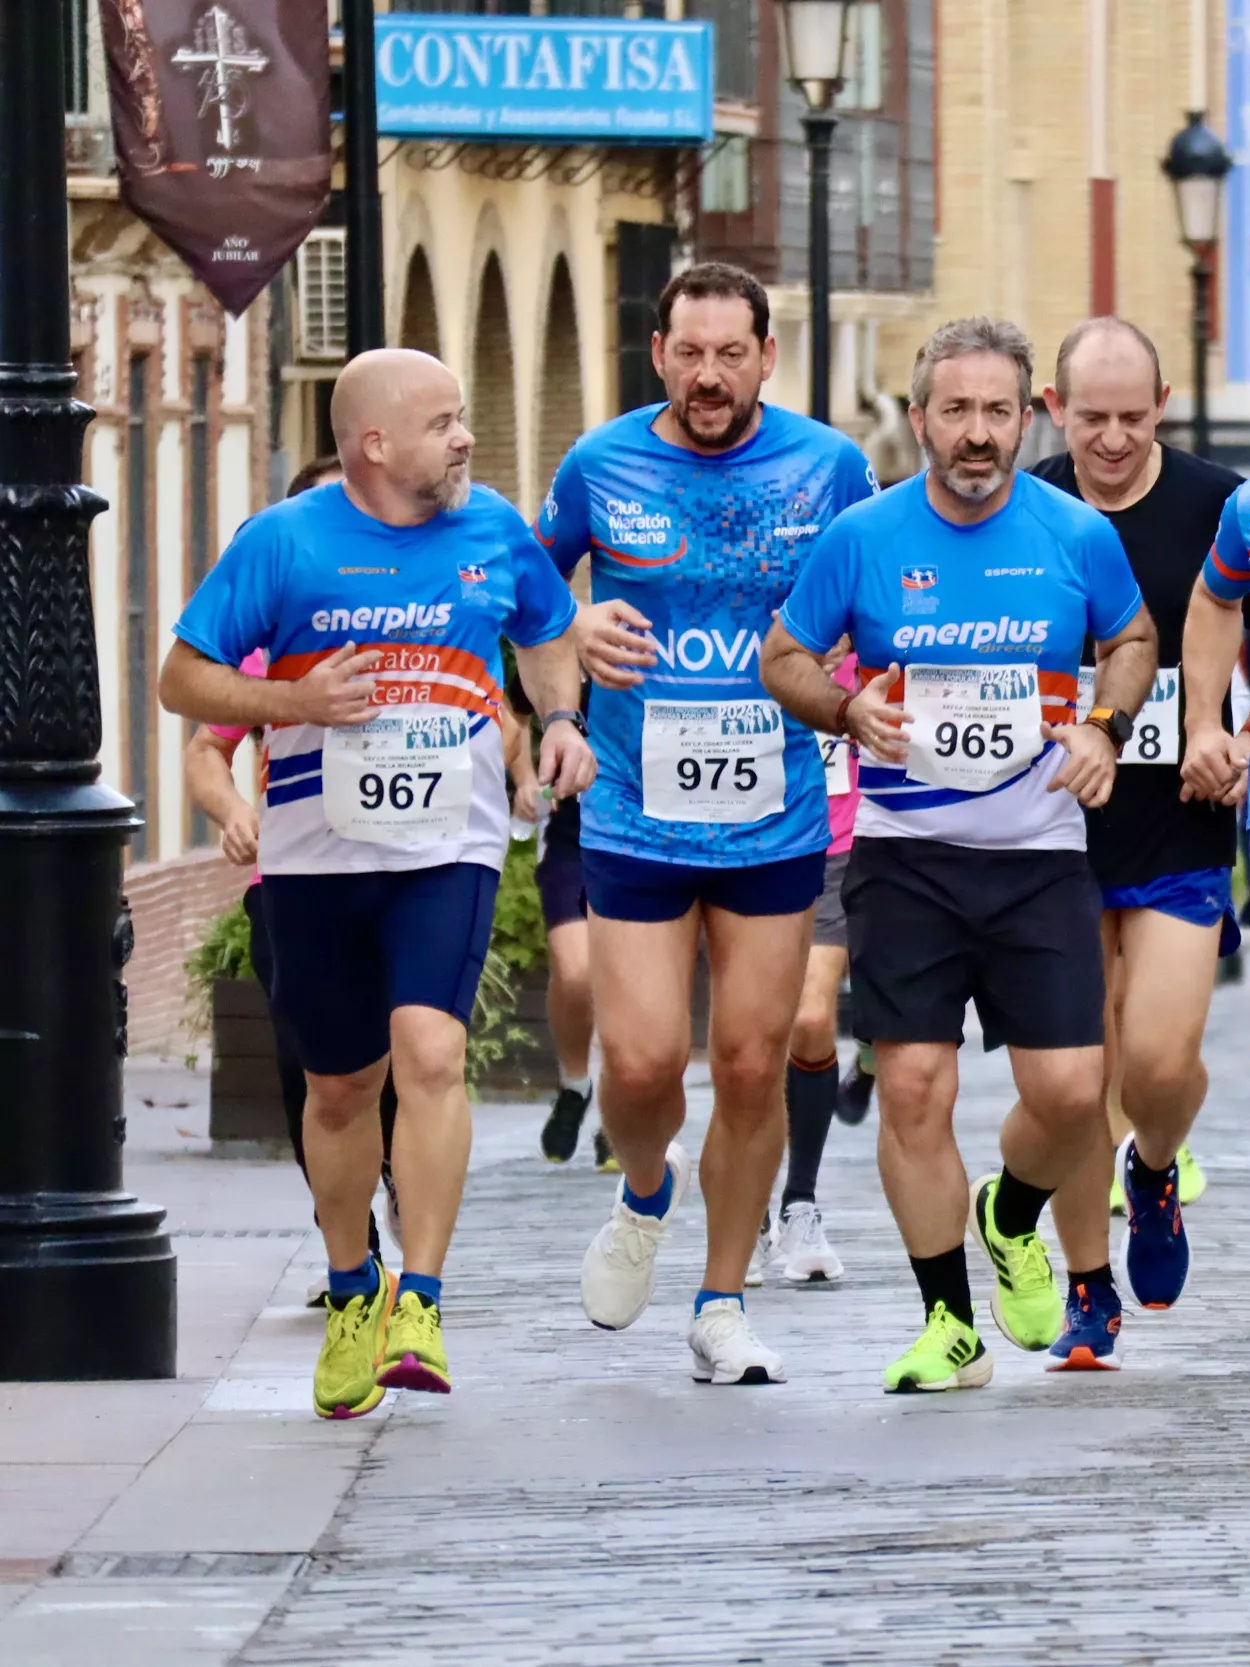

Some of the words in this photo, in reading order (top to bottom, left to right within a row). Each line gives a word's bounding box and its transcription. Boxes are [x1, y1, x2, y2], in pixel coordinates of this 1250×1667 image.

[379, 32, 698, 91] CONTAFISA
[222, 235, 248, 248] AÑO
[211, 250, 259, 262] JUBILAR
[606, 499, 642, 515] Club
[609, 513, 671, 530] Maratón
[774, 523, 819, 537] enerplus
[610, 530, 666, 545] Lucena
[984, 567, 1034, 577] GSPORT
[311, 602, 454, 636] enerplus
[892, 616, 1049, 649] enerplus
[370, 684, 431, 704] cena
[720, 704, 753, 720] 2024
[935, 722, 1014, 760] 965
[677, 757, 758, 791] 975
[359, 772, 442, 810] 967
